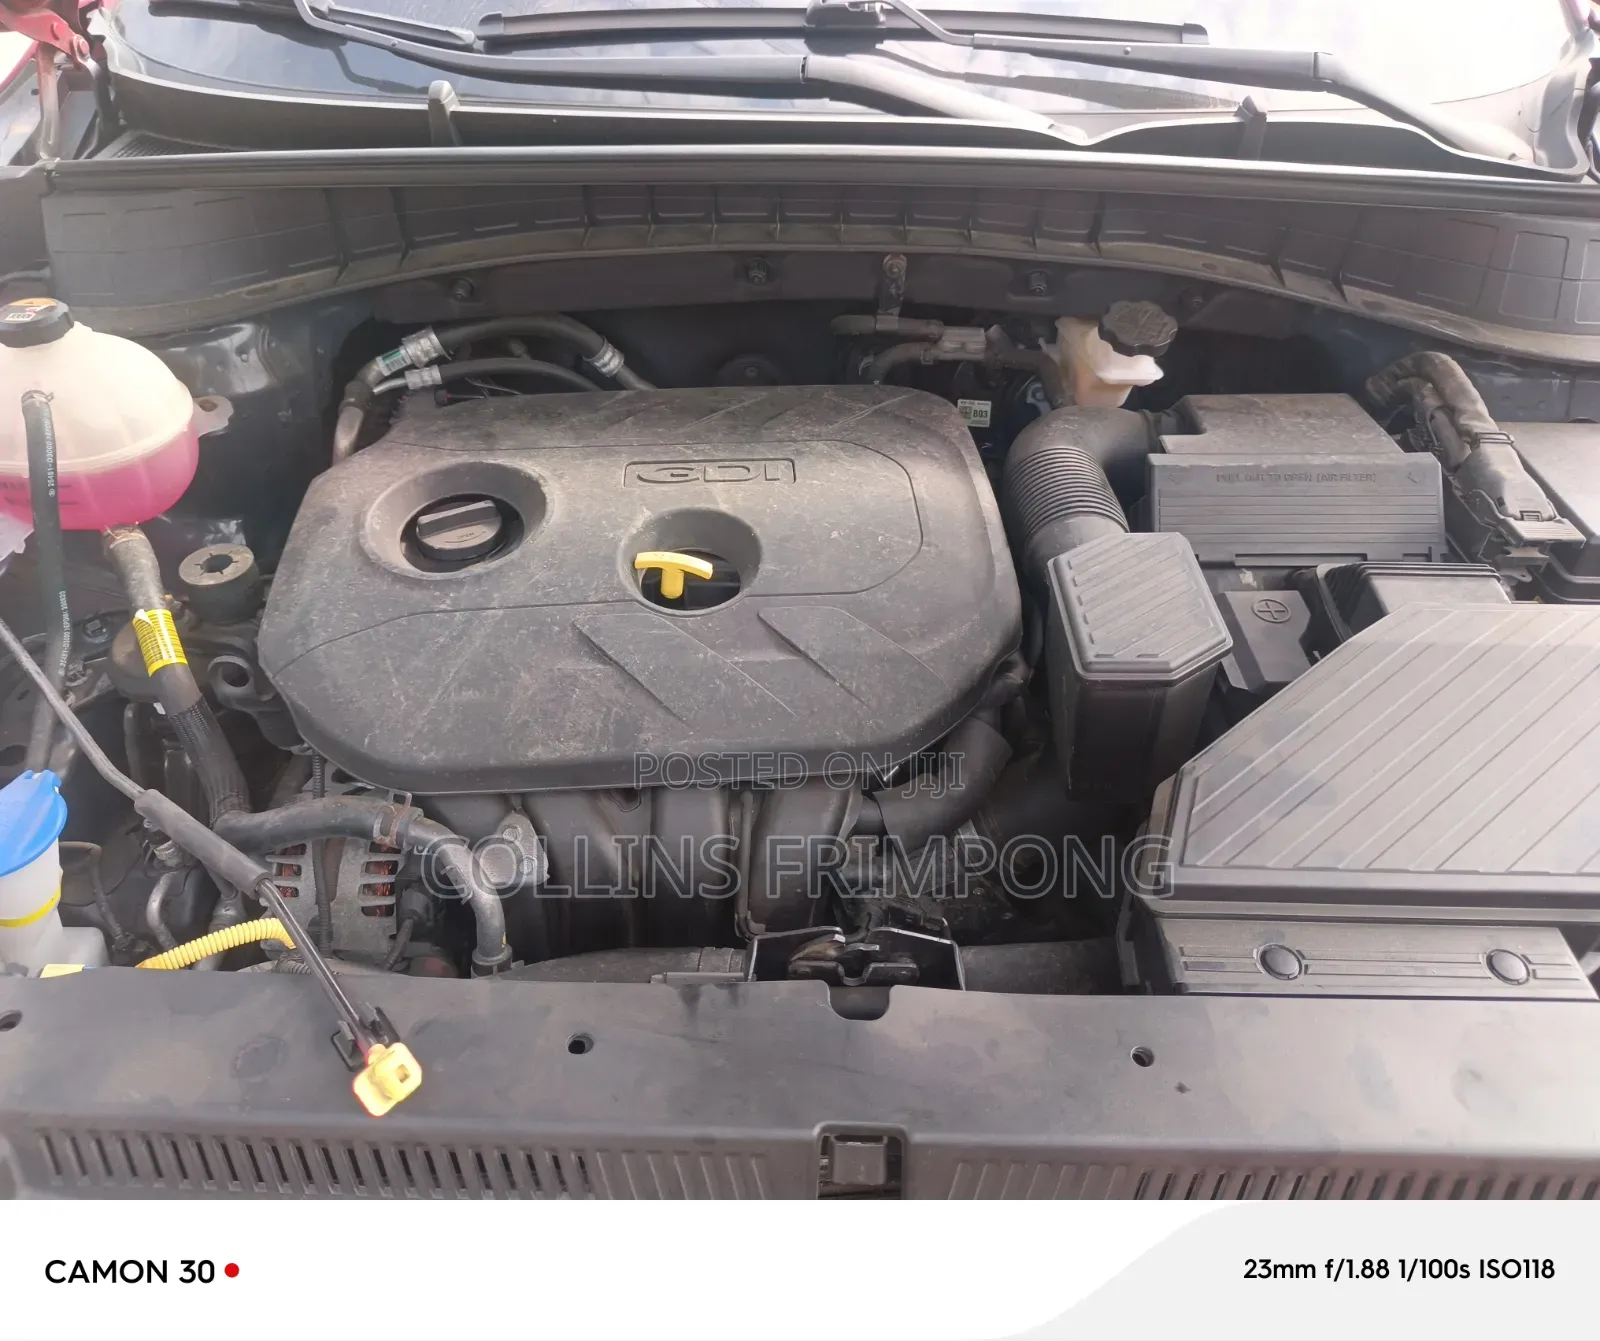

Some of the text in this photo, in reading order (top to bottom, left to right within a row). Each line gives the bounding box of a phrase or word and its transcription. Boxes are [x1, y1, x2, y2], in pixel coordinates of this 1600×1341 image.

[973, 410, 988, 418] 803
[636, 463, 781, 484] GDI
[1244, 472, 1265, 483] OUT
[1268, 472, 1282, 483] TO
[1284, 472, 1312, 483] OPEN
